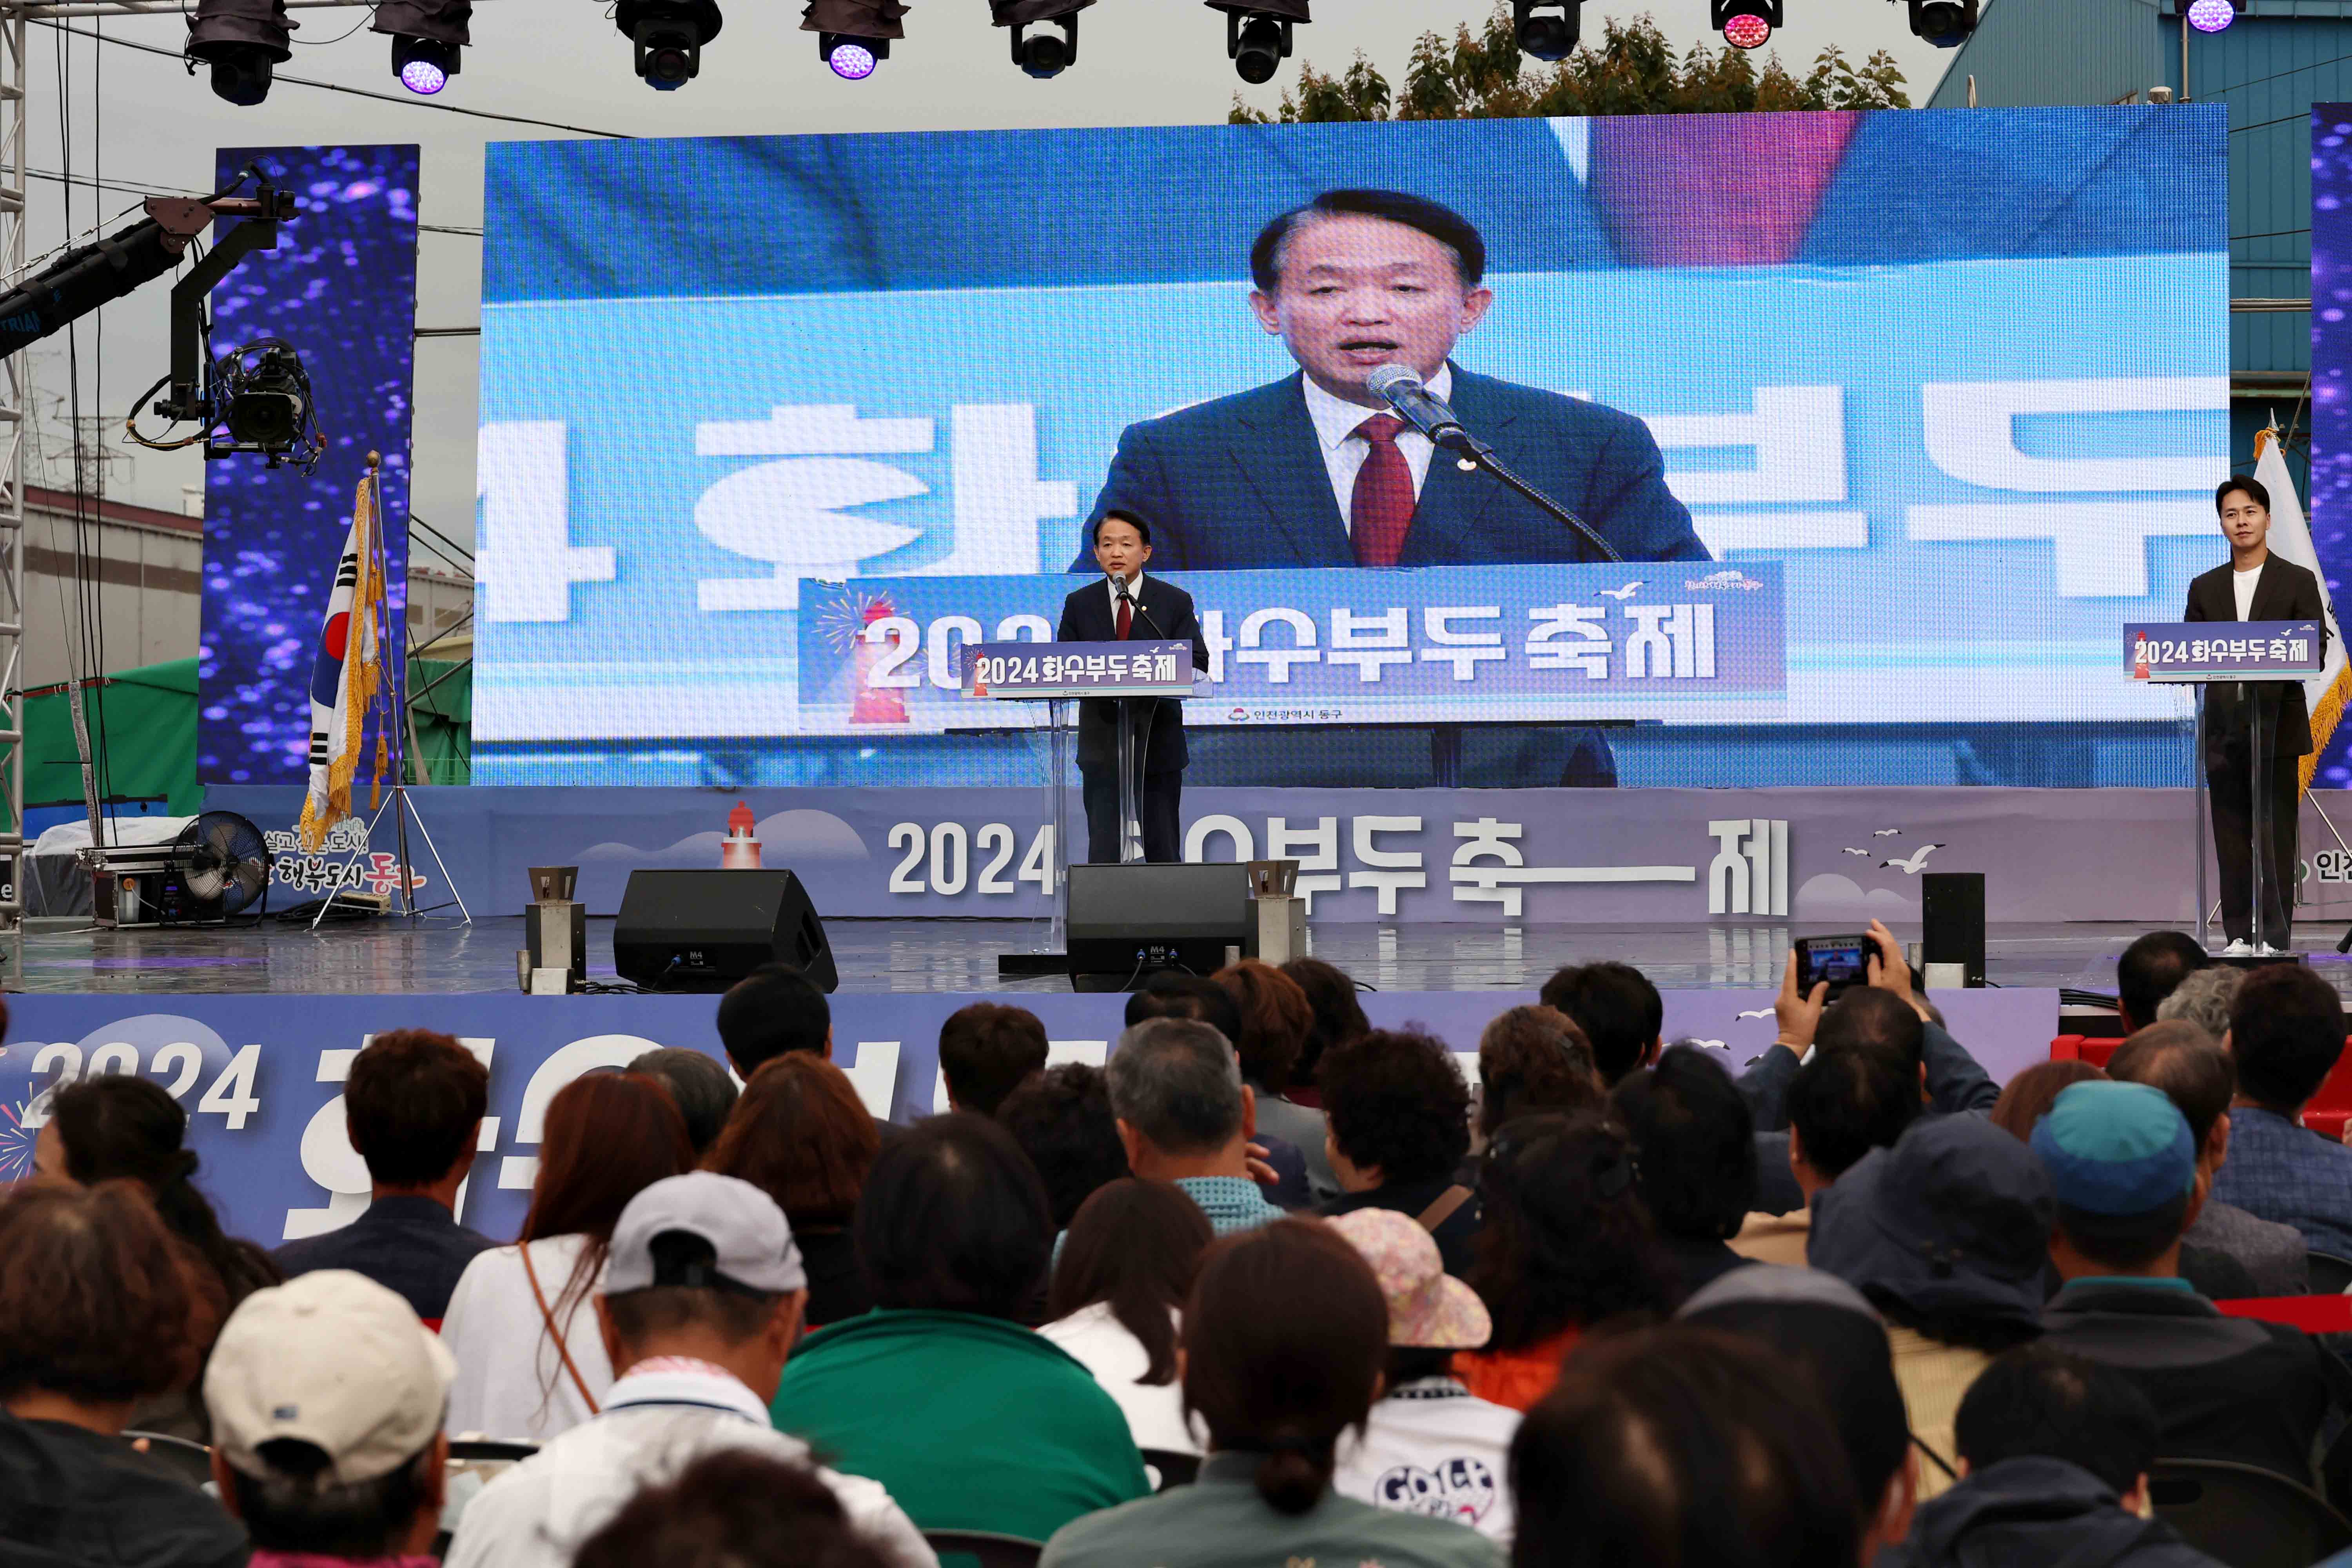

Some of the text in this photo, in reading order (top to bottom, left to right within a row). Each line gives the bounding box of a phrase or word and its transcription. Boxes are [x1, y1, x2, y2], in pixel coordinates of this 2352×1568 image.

[1525, 603, 1717, 681] 축제
[2135, 638, 2308, 664] 2024 화수부두 축제
[977, 653, 1177, 684] 2024 화수부두 축제
[1254, 710, 1343, 720] 인천광역시 동구
[887, 822, 1054, 895] 2024
[279, 858, 361, 892] 행복도시
